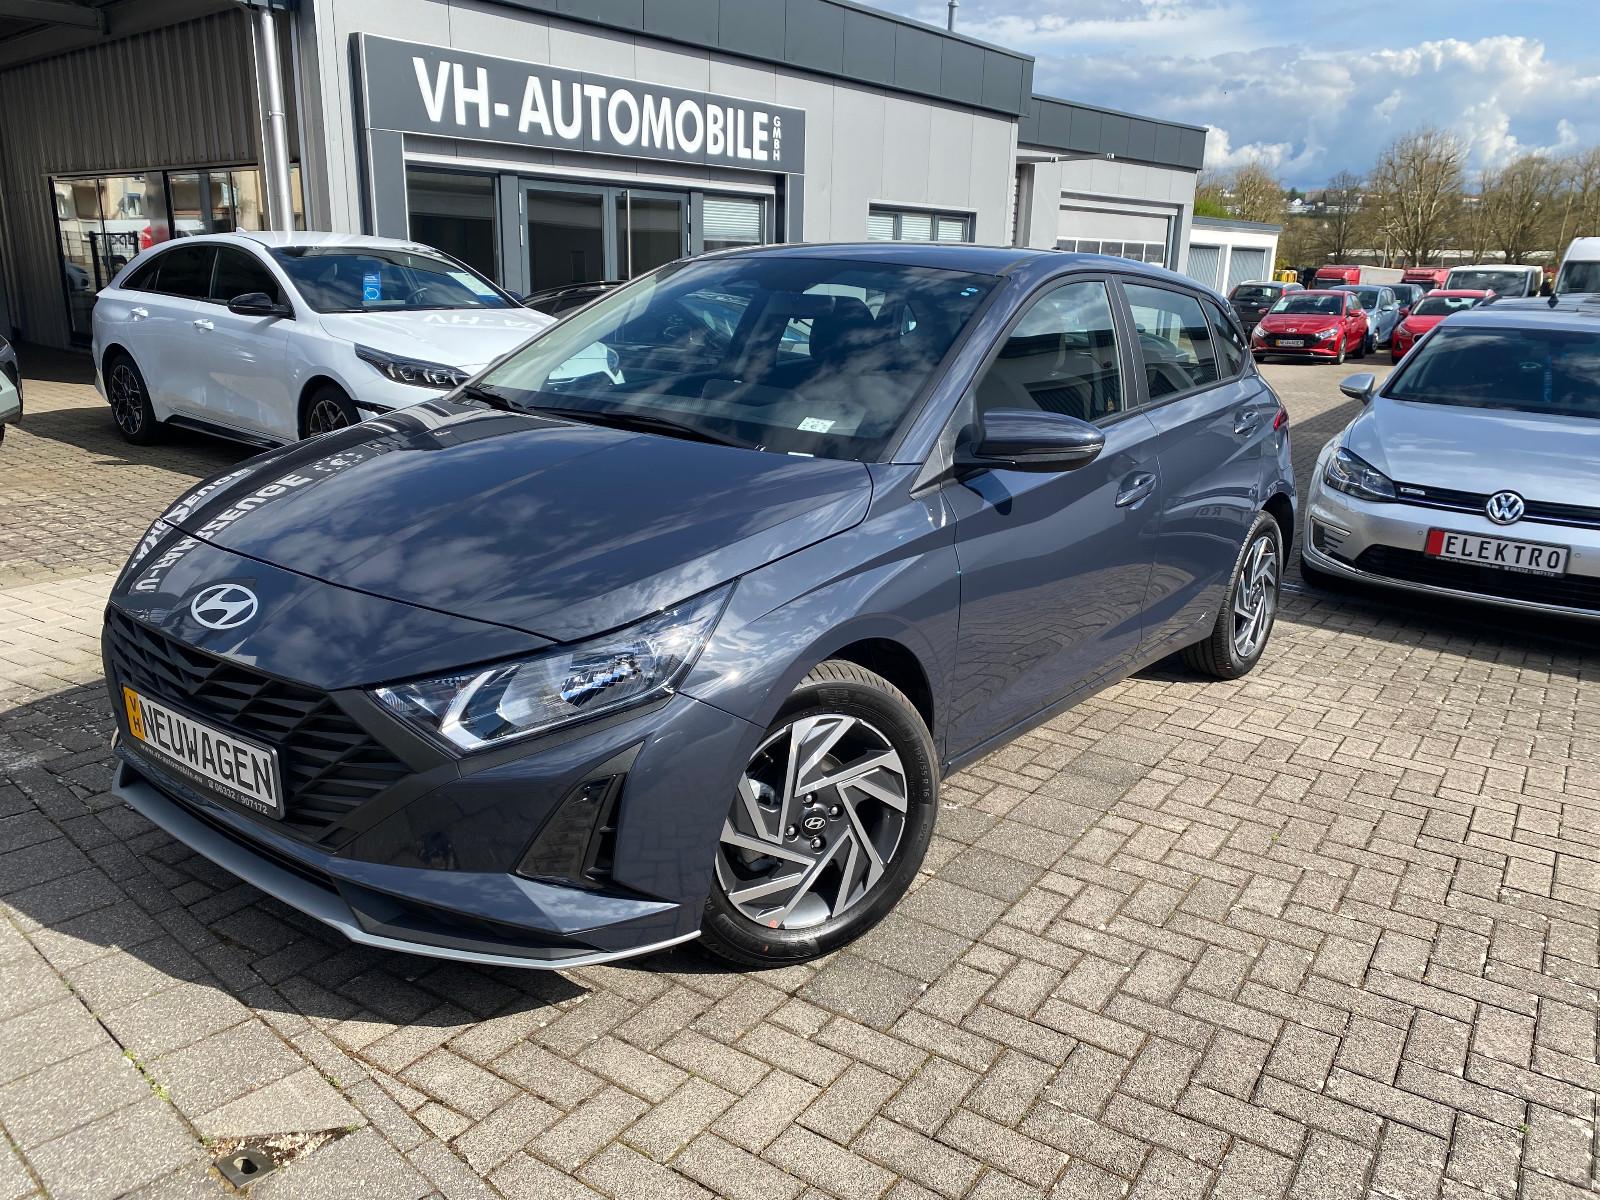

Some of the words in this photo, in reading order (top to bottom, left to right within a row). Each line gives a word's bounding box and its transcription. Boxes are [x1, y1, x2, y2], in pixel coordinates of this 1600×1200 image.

[412, 56, 509, 128] VH-
[518, 75, 769, 161] AUTOMOBILE
[772, 115, 782, 161] GMBH
[1445, 535, 1561, 569] ELEKTRO
[139, 699, 273, 800] NEUWAGEN
[215, 783, 236, 800] 06332
[240, 795, 268, 815] 907172
